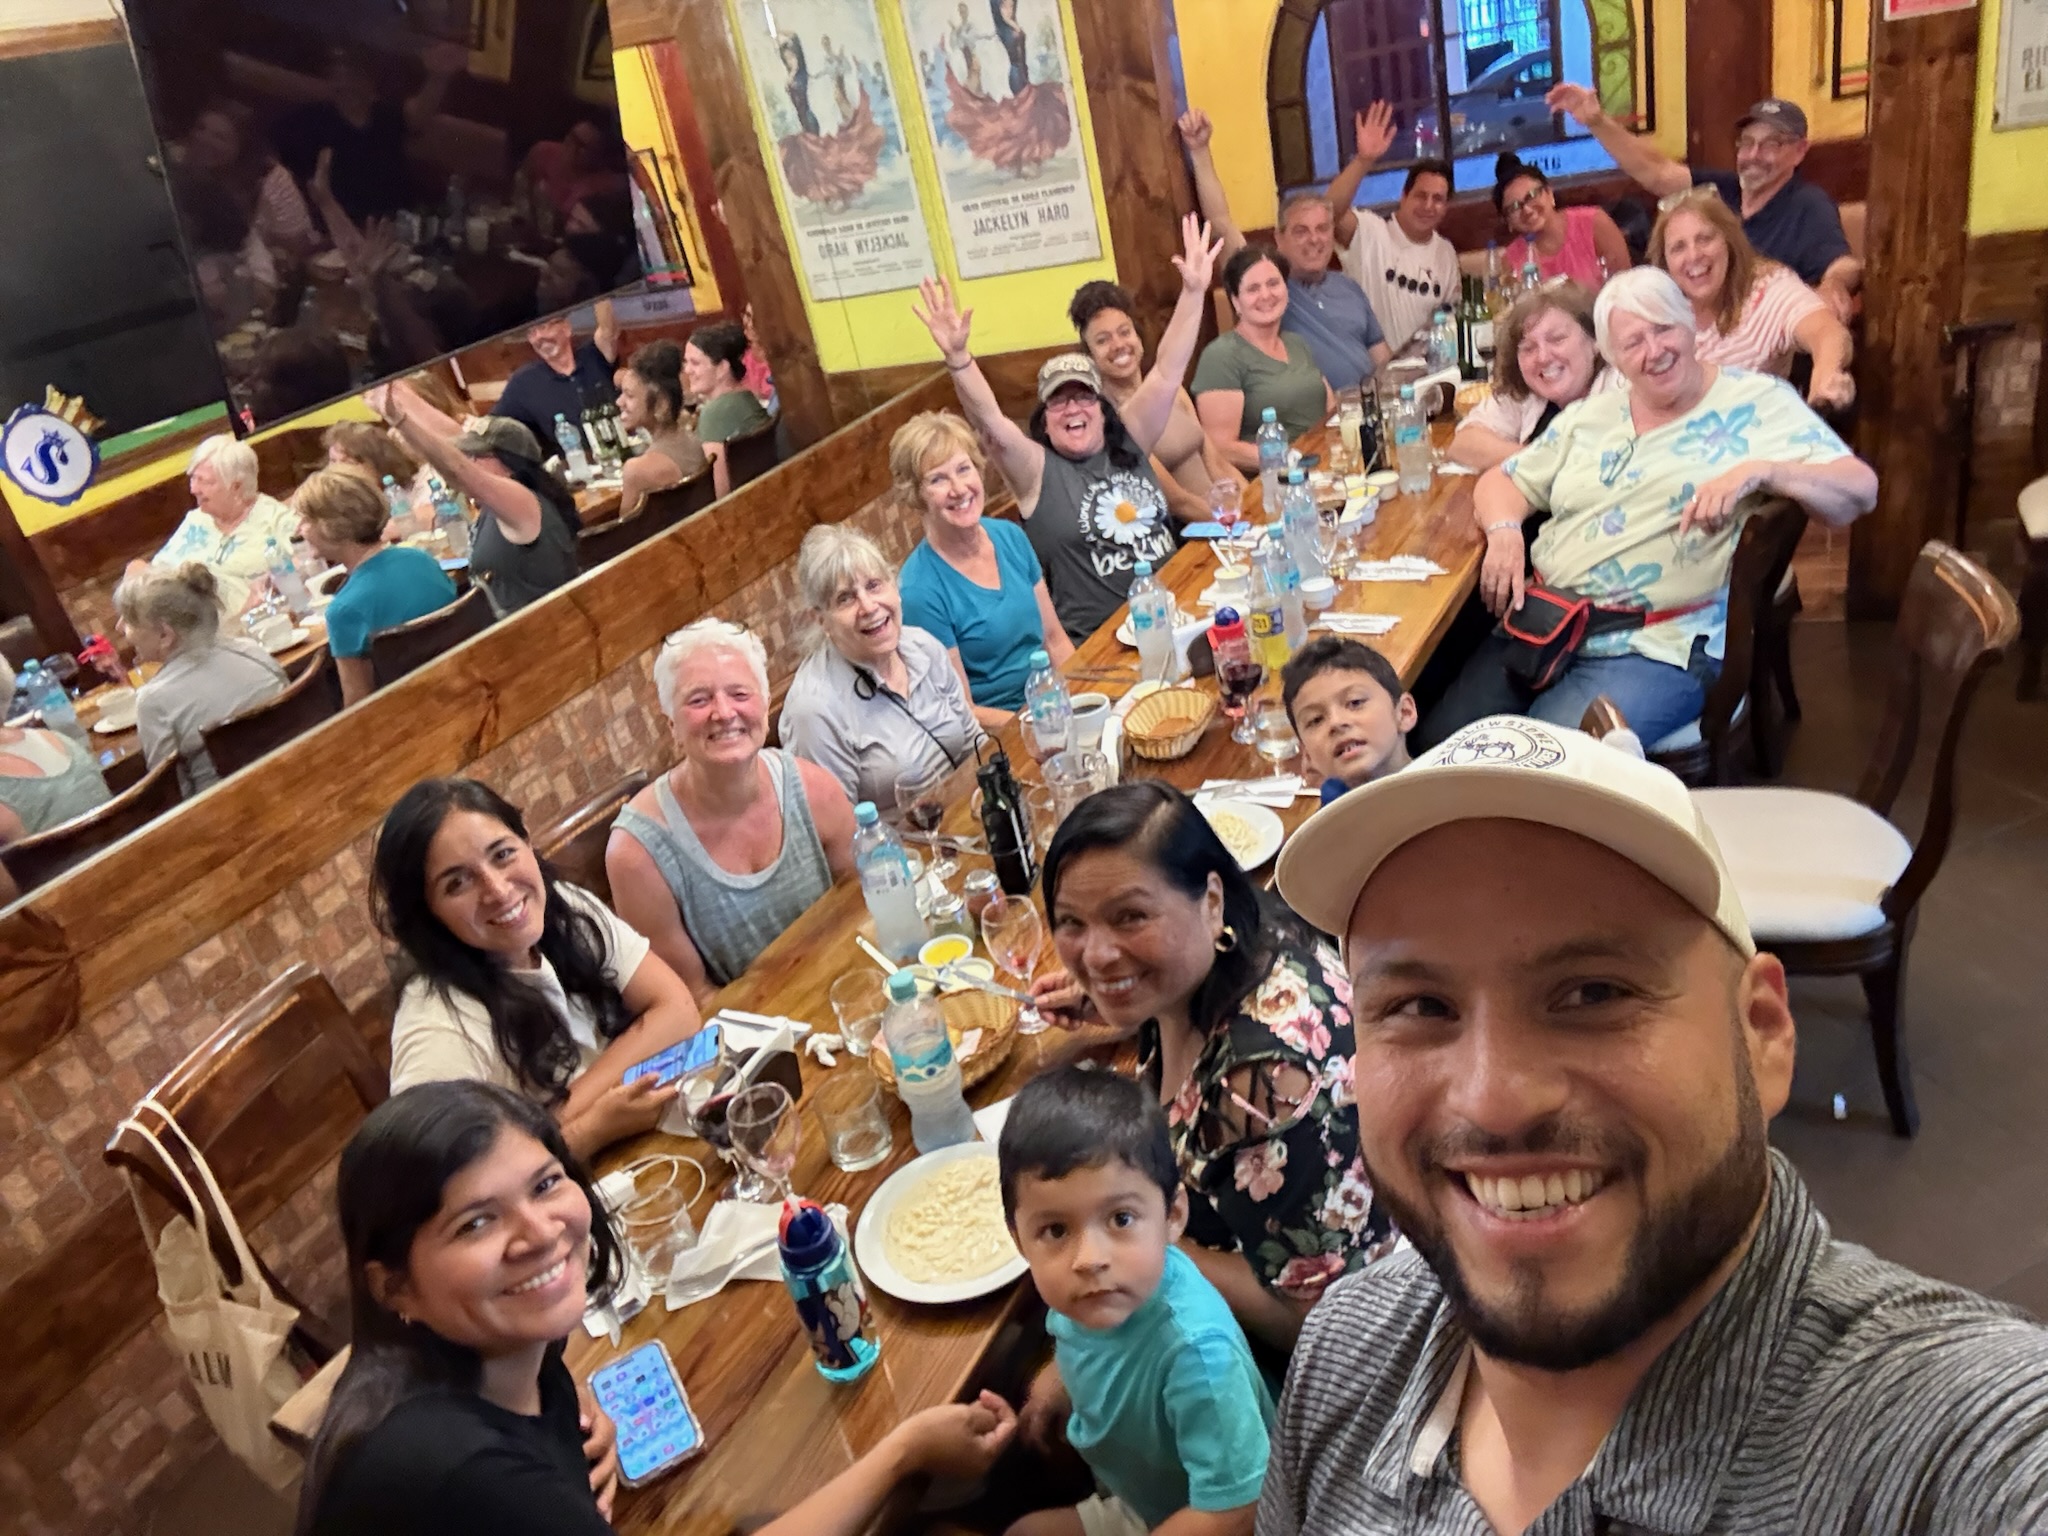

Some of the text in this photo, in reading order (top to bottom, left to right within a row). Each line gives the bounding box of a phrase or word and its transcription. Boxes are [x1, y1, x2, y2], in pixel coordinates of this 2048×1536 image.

[973, 202, 1071, 237] JACKELYN HARO
[1090, 549, 1134, 577] be
